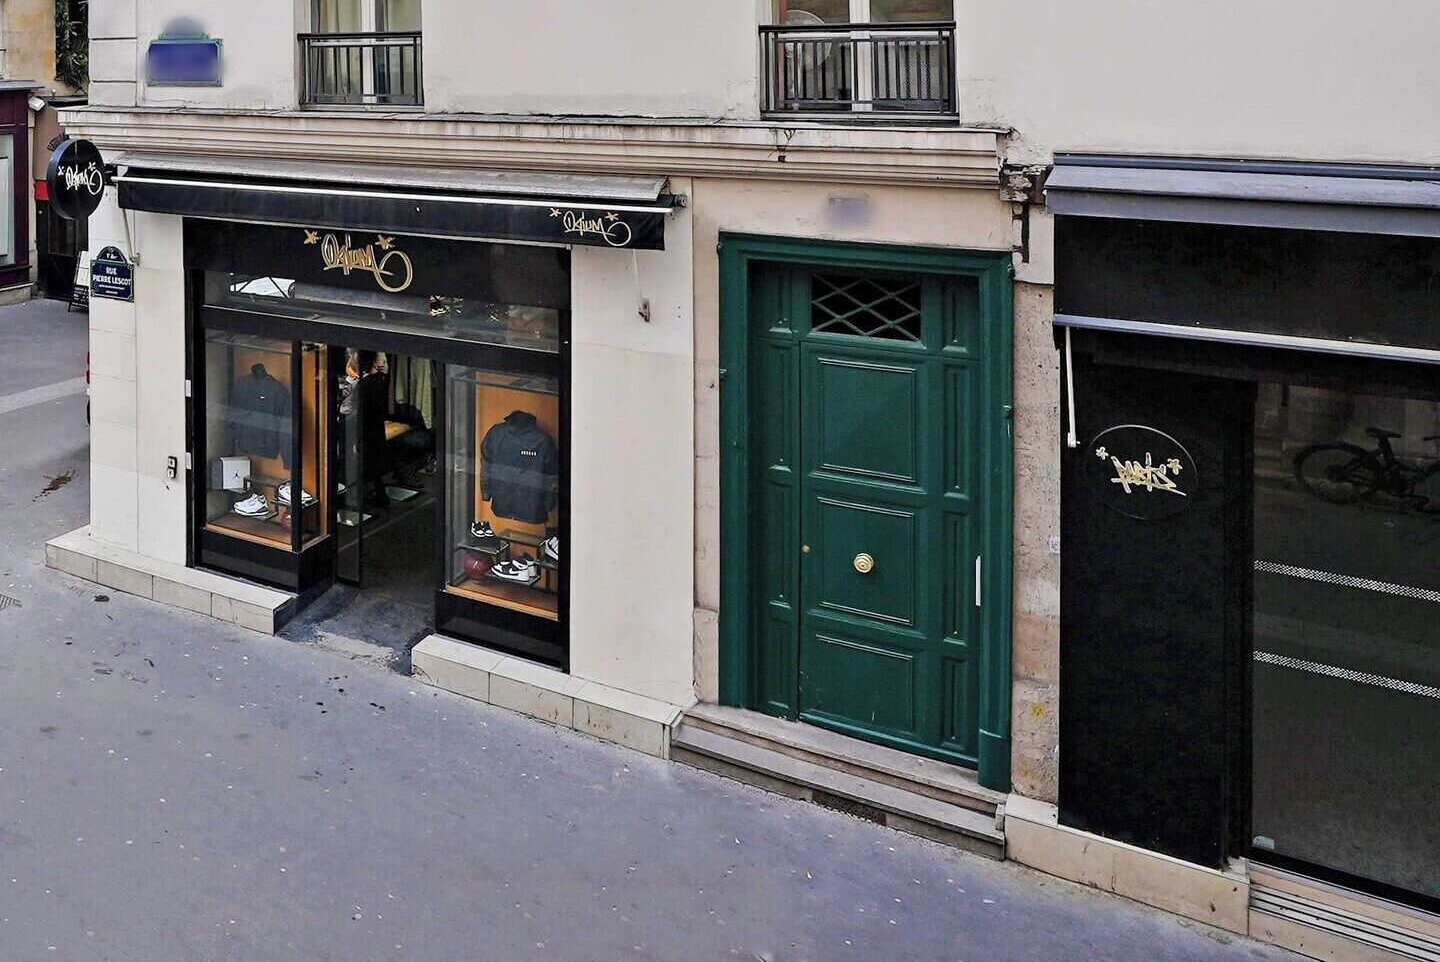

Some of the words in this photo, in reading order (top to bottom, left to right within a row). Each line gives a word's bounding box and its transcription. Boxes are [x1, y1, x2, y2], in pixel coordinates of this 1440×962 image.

[105, 267, 117, 275] RUE
[92, 274, 111, 283] PIERRE
[111, 277, 131, 286] LESCOT
